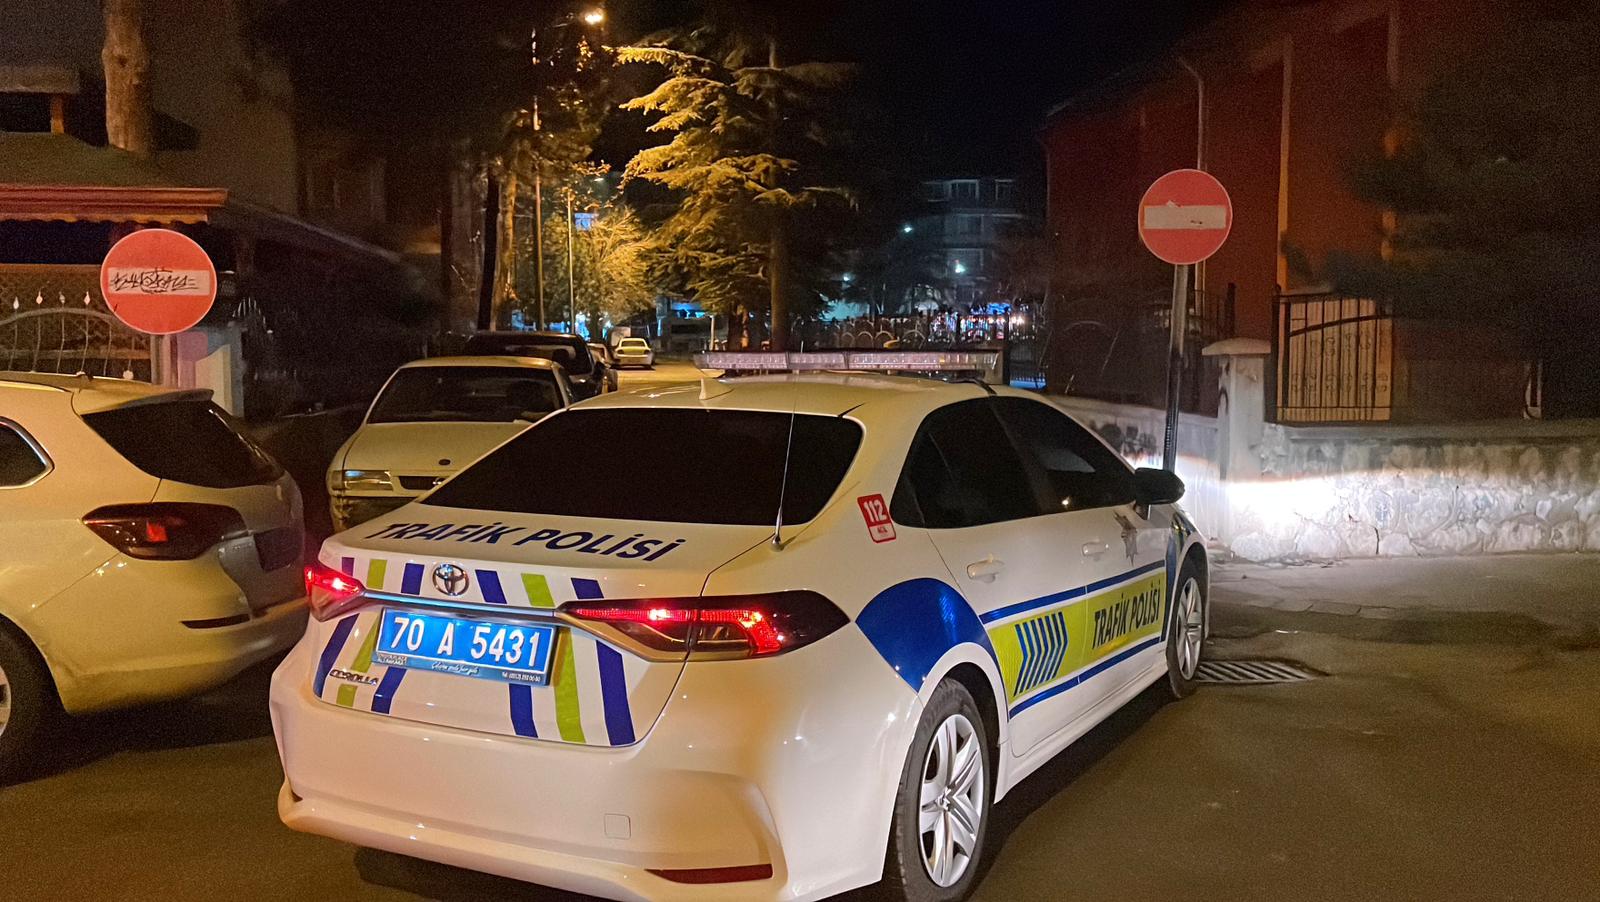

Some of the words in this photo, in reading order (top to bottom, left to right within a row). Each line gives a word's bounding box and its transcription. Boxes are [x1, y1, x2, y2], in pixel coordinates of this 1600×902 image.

[864, 499, 887, 522] 112
[365, 521, 527, 545] TRAFİK
[511, 526, 687, 562] POLİSİ
[1092, 593, 1131, 650] TRAFİK
[1129, 580, 1161, 632] POLİSİ
[390, 617, 424, 651] 70
[437, 622, 456, 656] A
[470, 626, 541, 667] 5431
